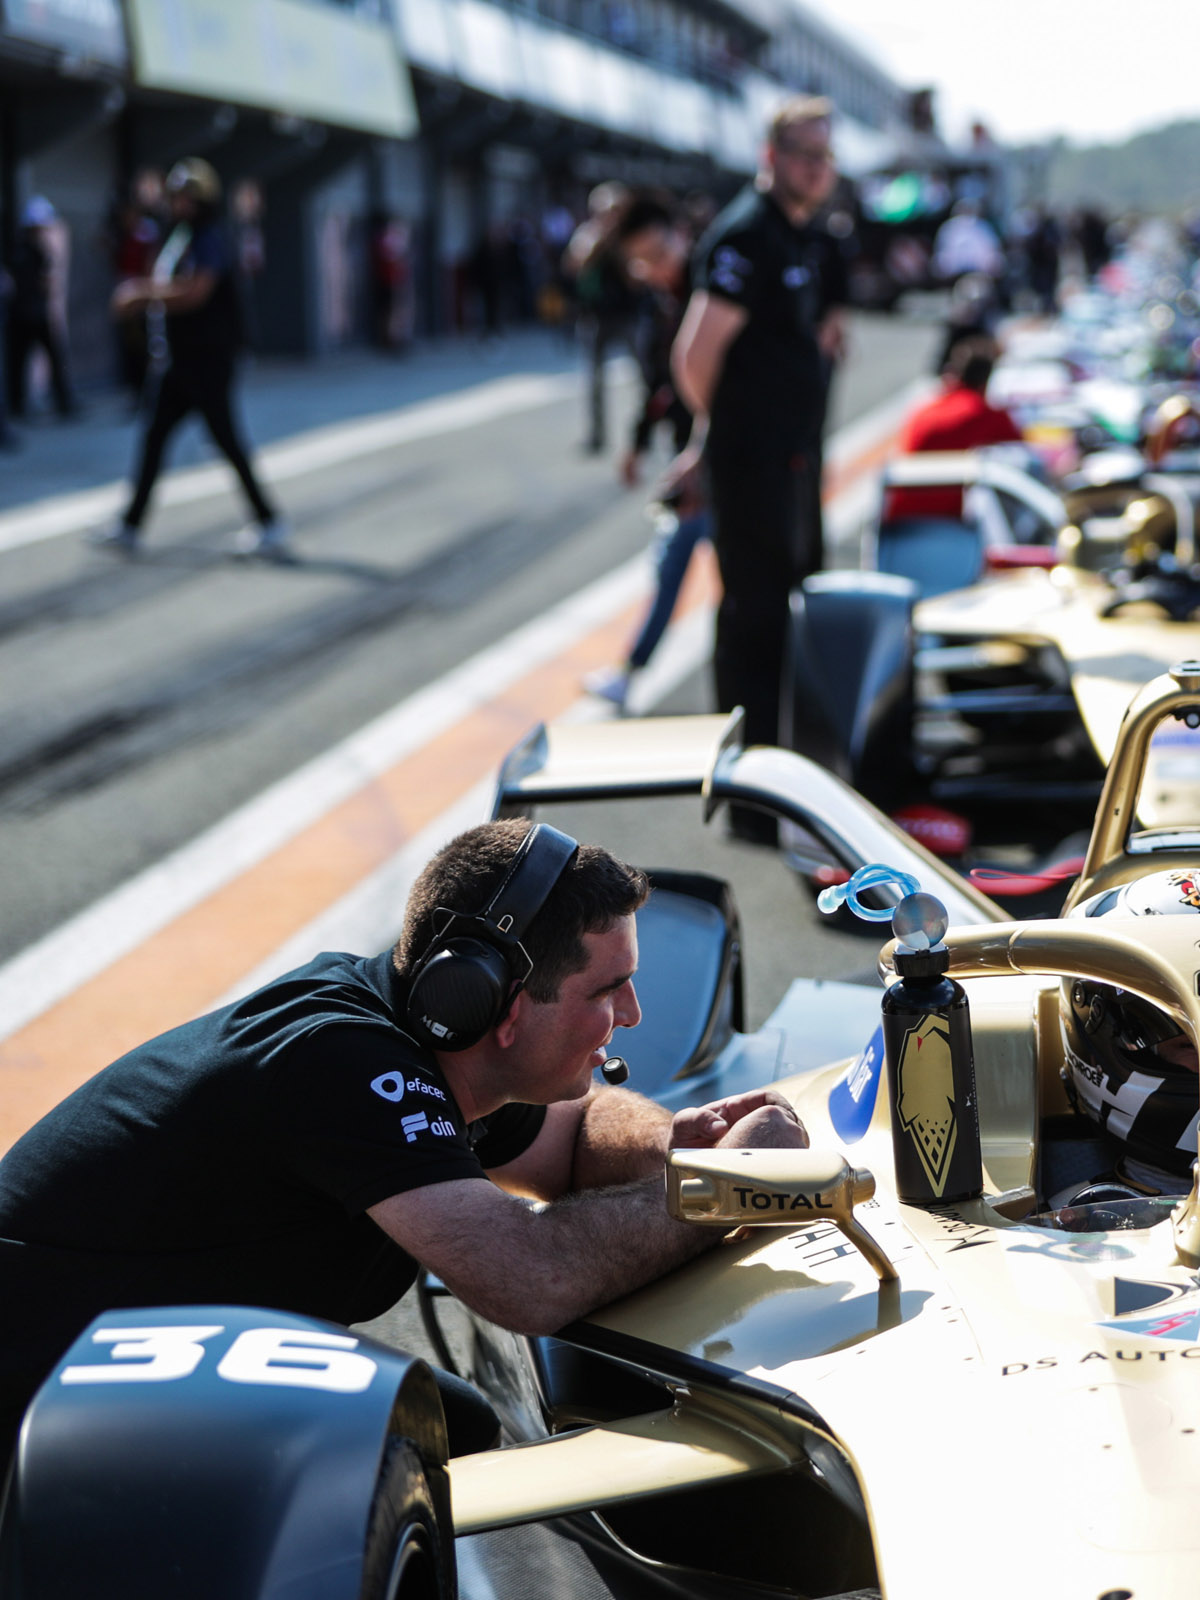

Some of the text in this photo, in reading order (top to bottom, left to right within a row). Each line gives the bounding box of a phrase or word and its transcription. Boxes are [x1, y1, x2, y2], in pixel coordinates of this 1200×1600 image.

[733, 1186, 833, 1210] TOTAL
[59, 1325, 378, 1393] 36
[1001, 1356, 1058, 1376] DS
